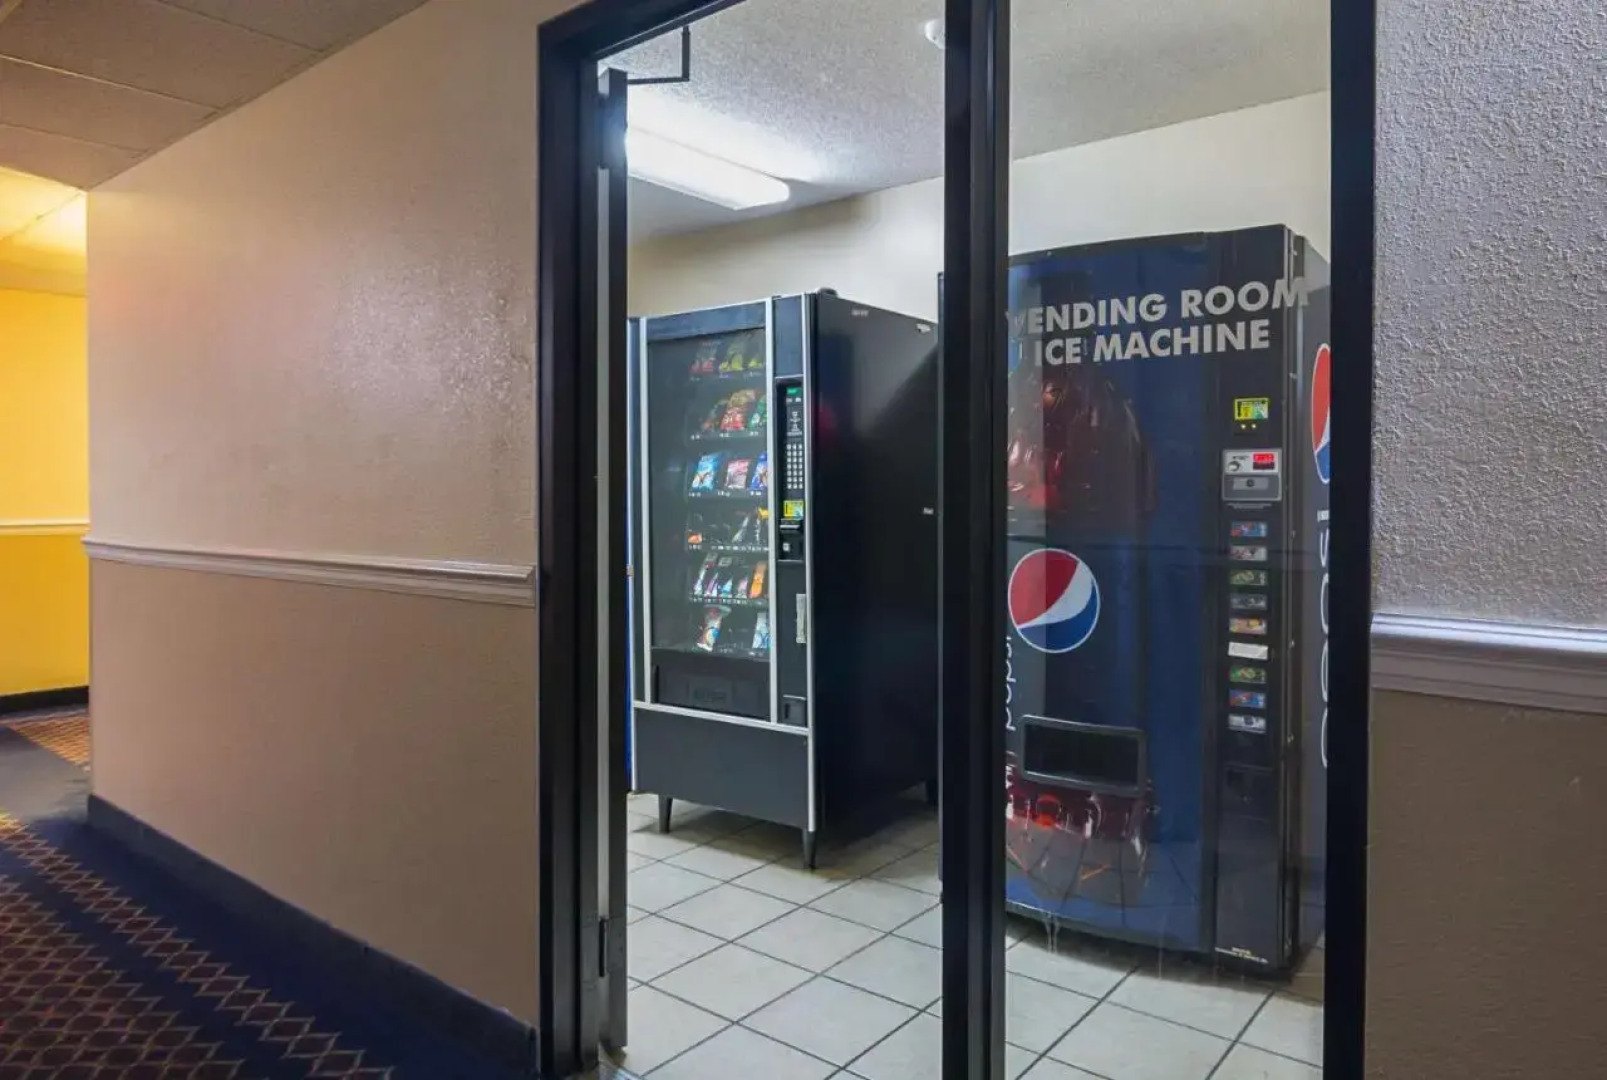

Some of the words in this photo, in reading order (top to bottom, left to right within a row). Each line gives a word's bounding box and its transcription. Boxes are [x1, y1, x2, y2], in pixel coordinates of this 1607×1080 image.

[1005, 293, 1167, 335] VENDING
[1181, 276, 1309, 319] ROOM
[1034, 337, 1082, 366] ICE
[1093, 319, 1270, 362] MACHINE
